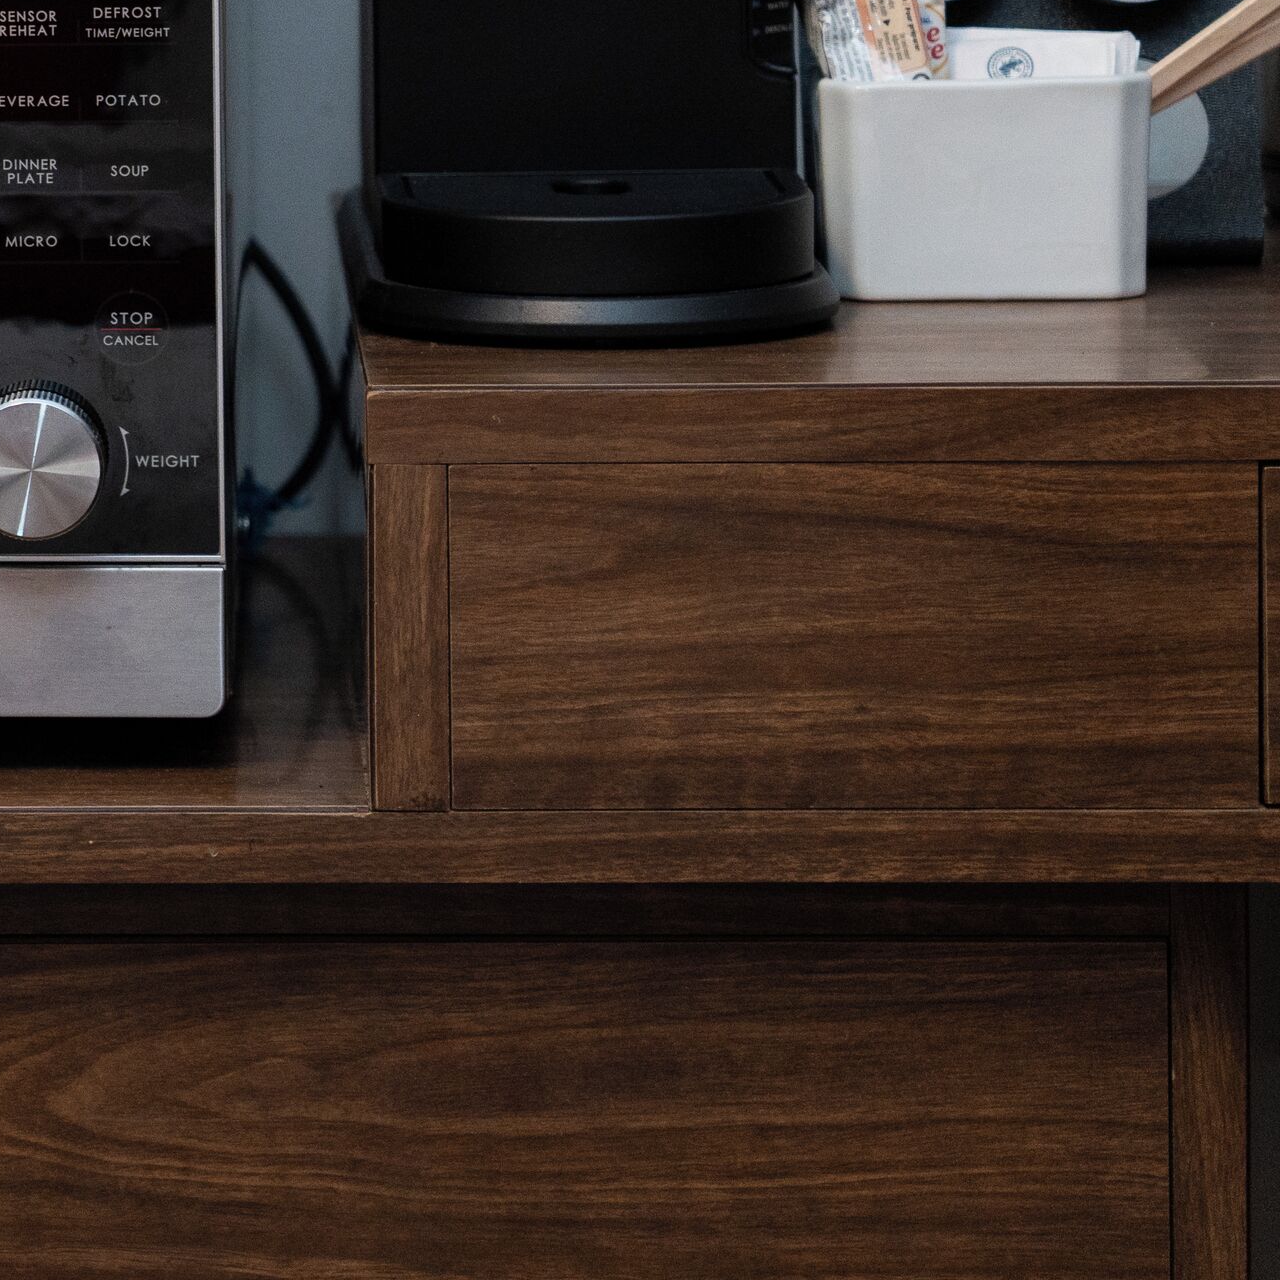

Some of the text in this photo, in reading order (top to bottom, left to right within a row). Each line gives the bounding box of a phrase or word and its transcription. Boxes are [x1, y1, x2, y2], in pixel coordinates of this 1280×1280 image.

[0, 10, 57, 23] SENSOR
[92, 6, 162, 19] DEFROST
[0, 24, 57, 37] REHEAT
[85, 26, 171, 40] TIME/WEIGHT
[96, 94, 161, 107] POTATO
[2, 158, 57, 171] DINNER
[110, 165, 149, 178] SOUP
[7, 172, 54, 185] PLATE
[5, 235, 58, 249] MICRO
[109, 235, 151, 248] LOCK
[110, 311, 153, 325] STOP
[102, 335, 159, 347] CANCEL
[135, 455, 200, 469] WEIGHT
